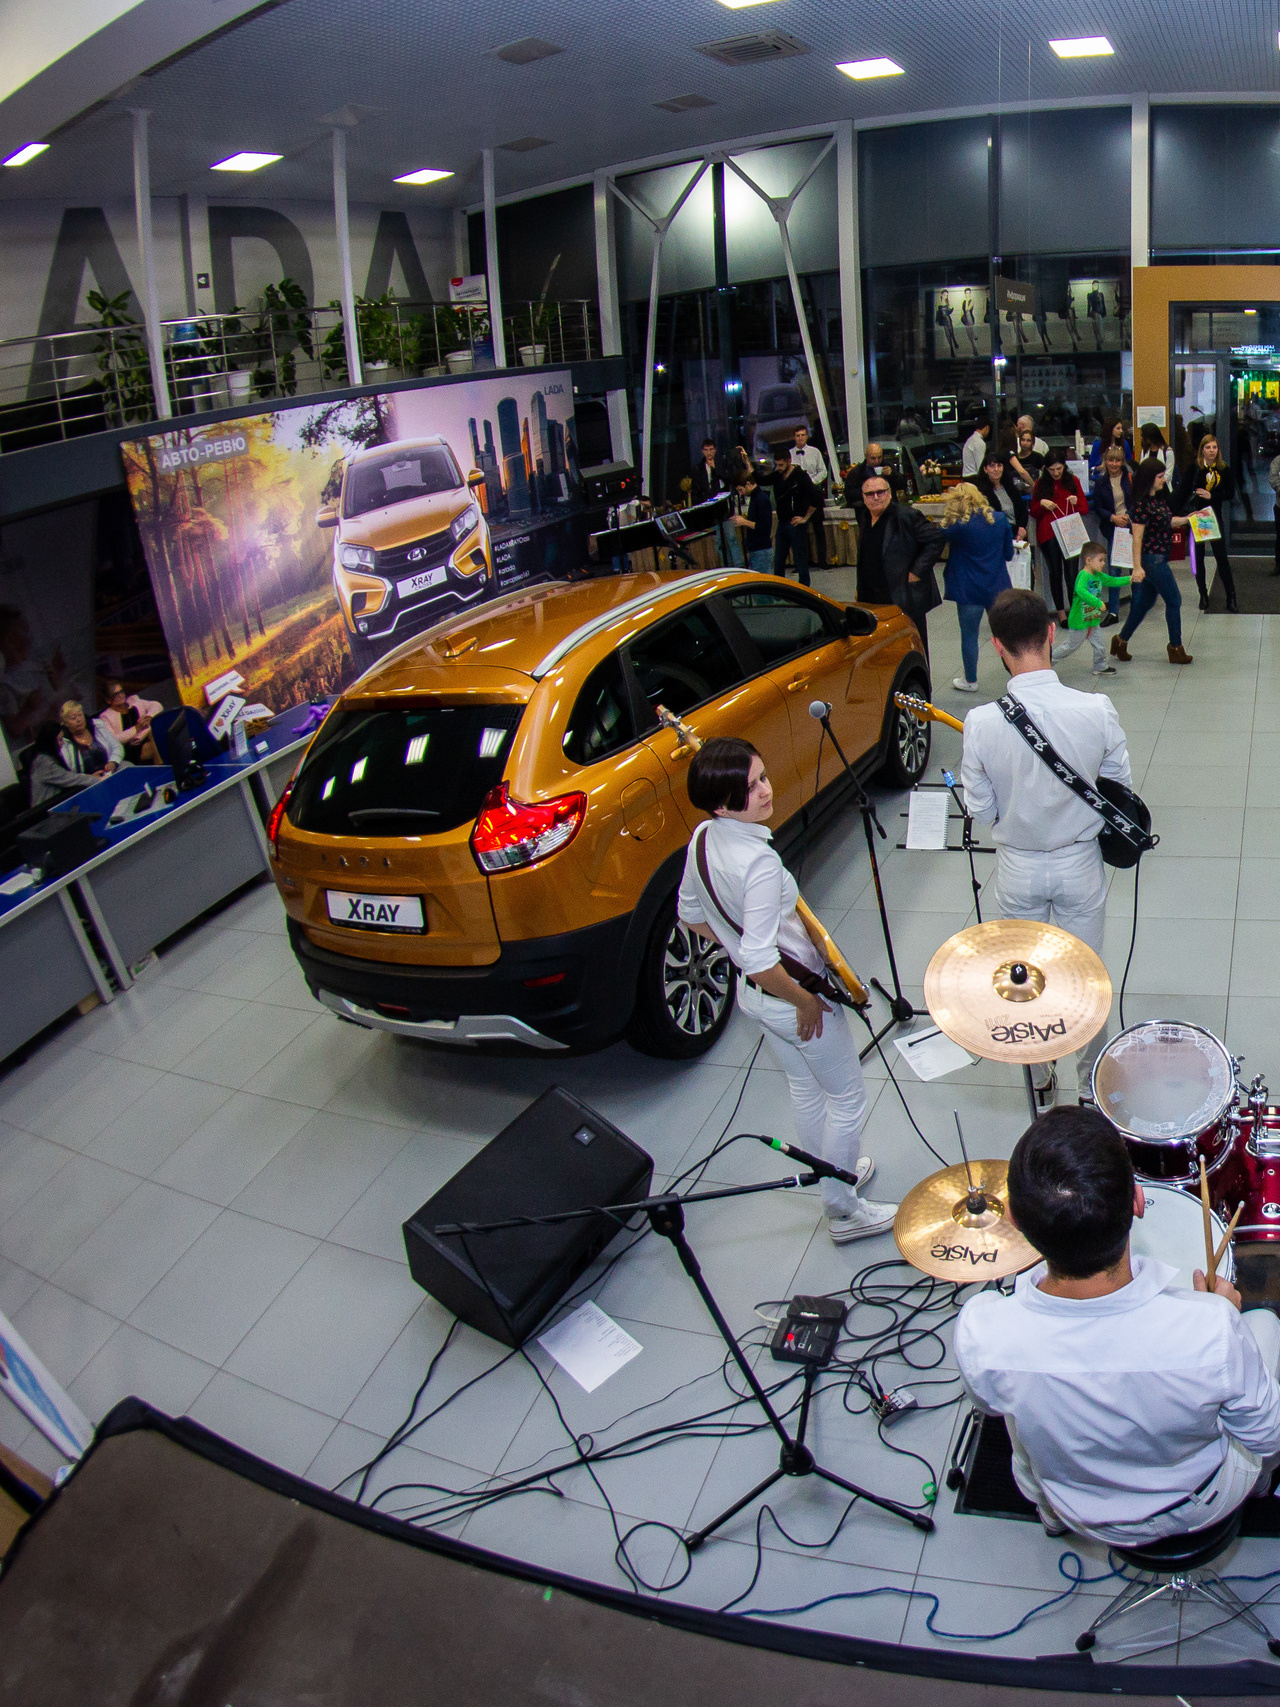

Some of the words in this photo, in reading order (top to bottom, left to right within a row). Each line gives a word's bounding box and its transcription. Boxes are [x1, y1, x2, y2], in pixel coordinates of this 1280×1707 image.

[543, 384, 564, 395] LADA
[162, 437, 245, 468] АВТО-РЕВЮ
[411, 573, 434, 588] XRAY
[221, 700, 236, 719] XRAY
